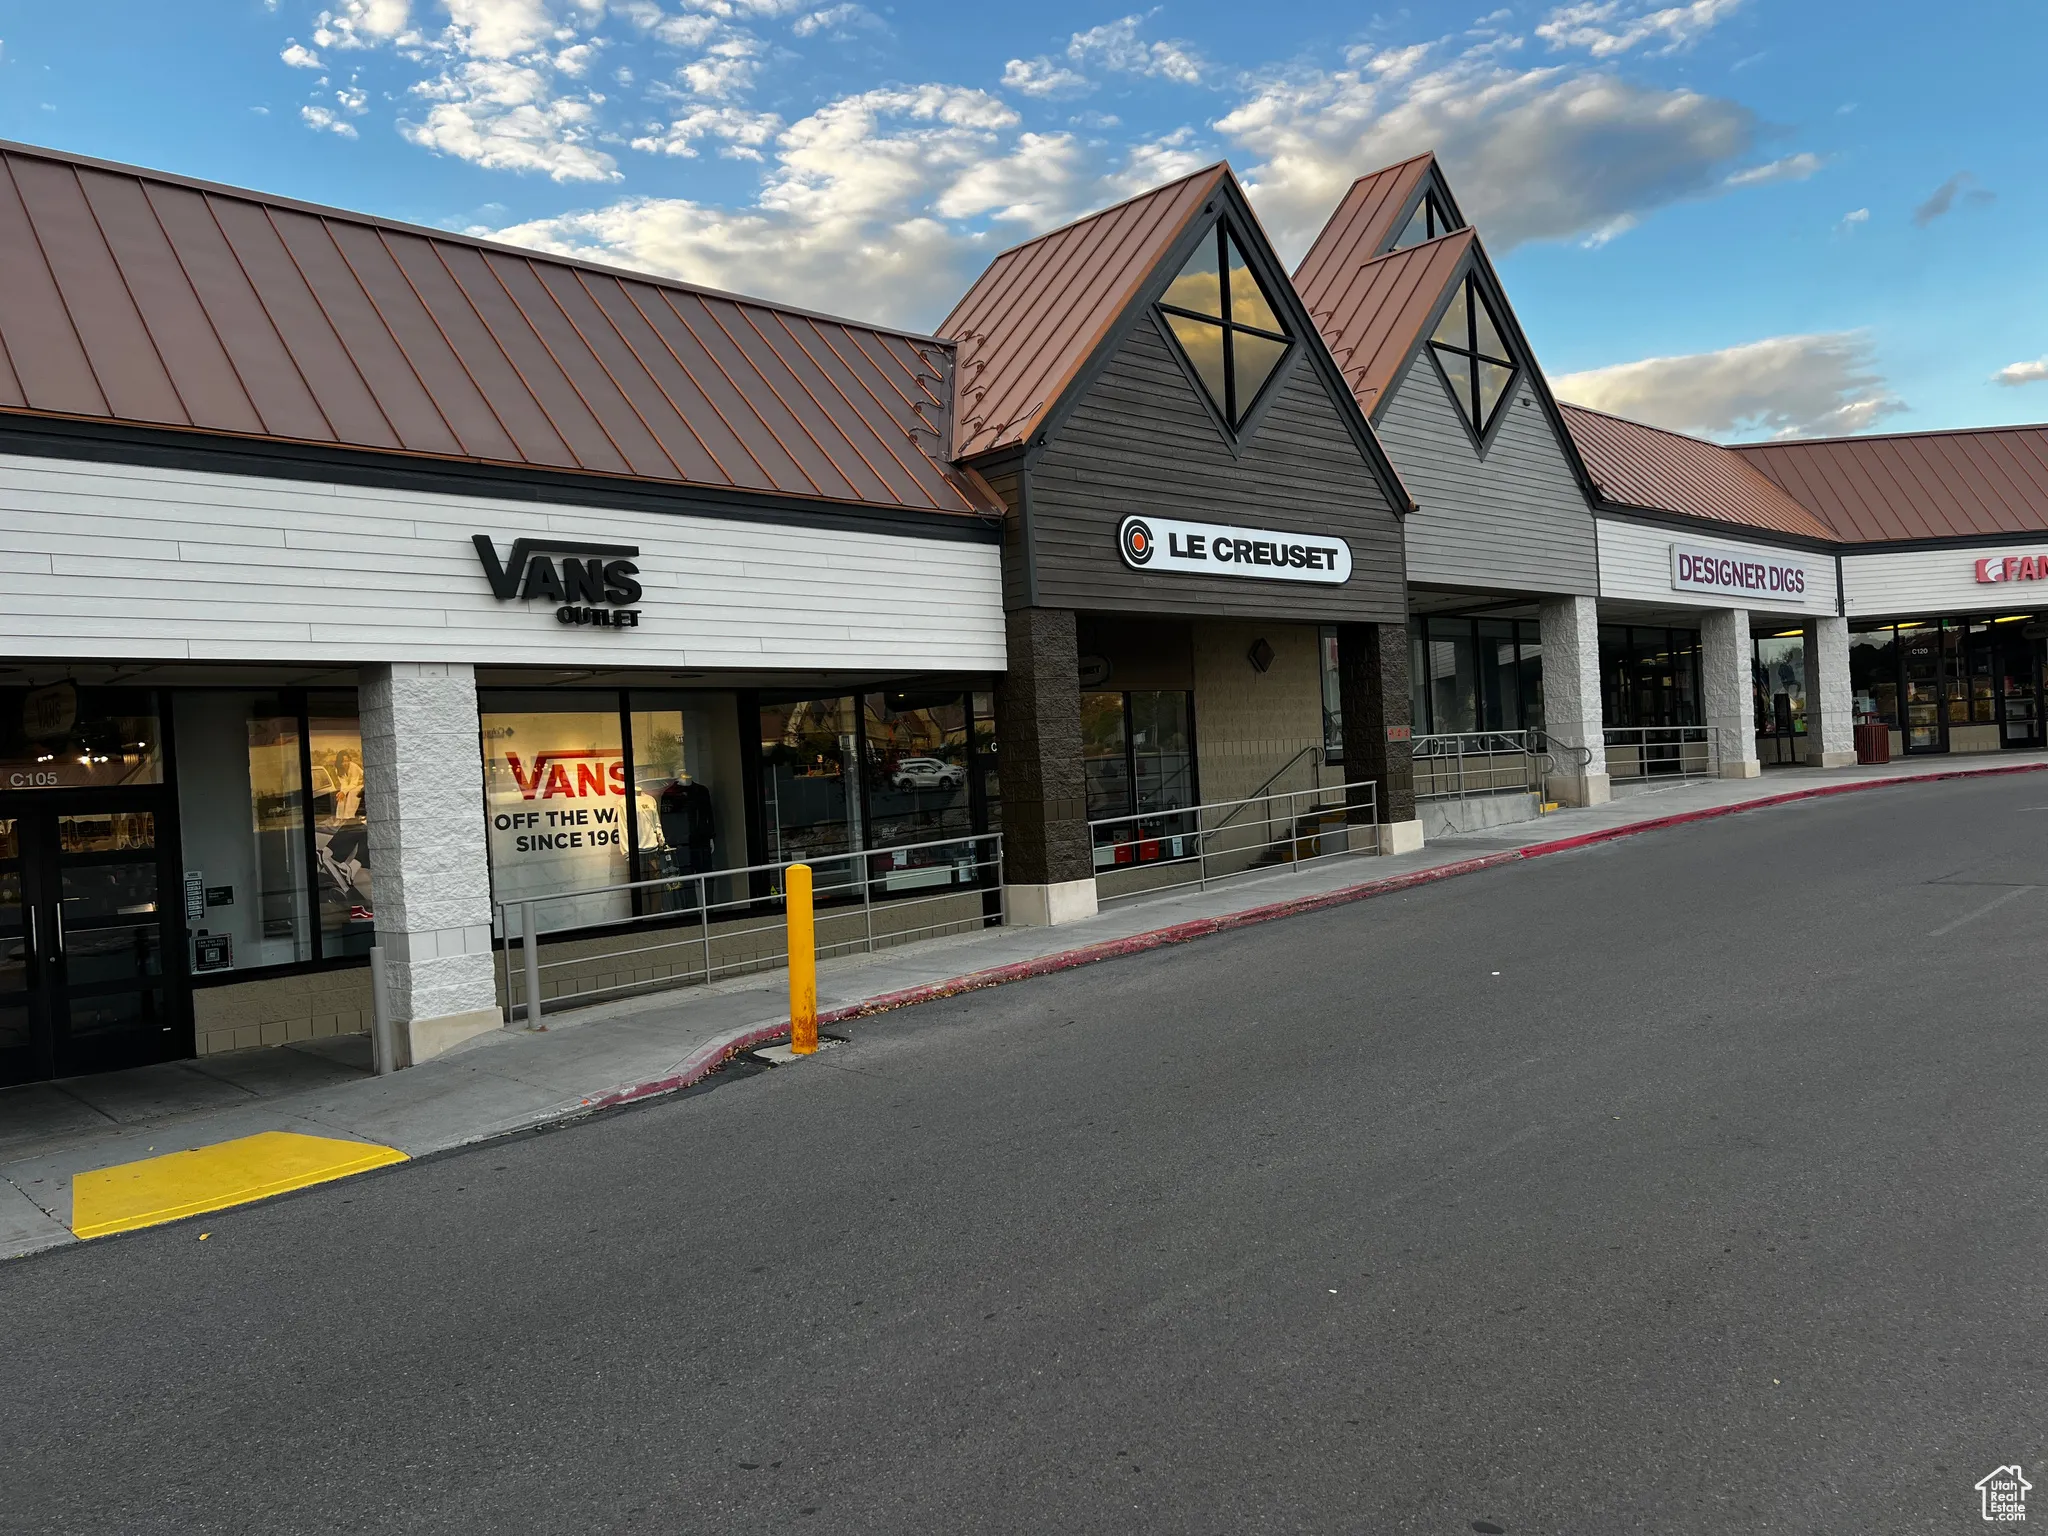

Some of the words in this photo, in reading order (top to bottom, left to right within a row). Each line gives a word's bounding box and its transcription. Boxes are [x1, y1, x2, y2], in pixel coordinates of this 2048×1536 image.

[1168, 532, 1207, 560] LE
[1212, 537, 1338, 571] CREUSET
[471, 534, 643, 605] VANS
[1679, 553, 1766, 590] DESIGNER
[1769, 565, 1805, 594] DIGS
[556, 605, 643, 628] OUTLET
[1911, 647, 1929, 655] C120
[10, 771, 58, 787] C105
[504, 748, 630, 800] VANS
[494, 812, 540, 831] OFF
[545, 809, 589, 828] THE
[516, 831, 583, 852] SINCE
